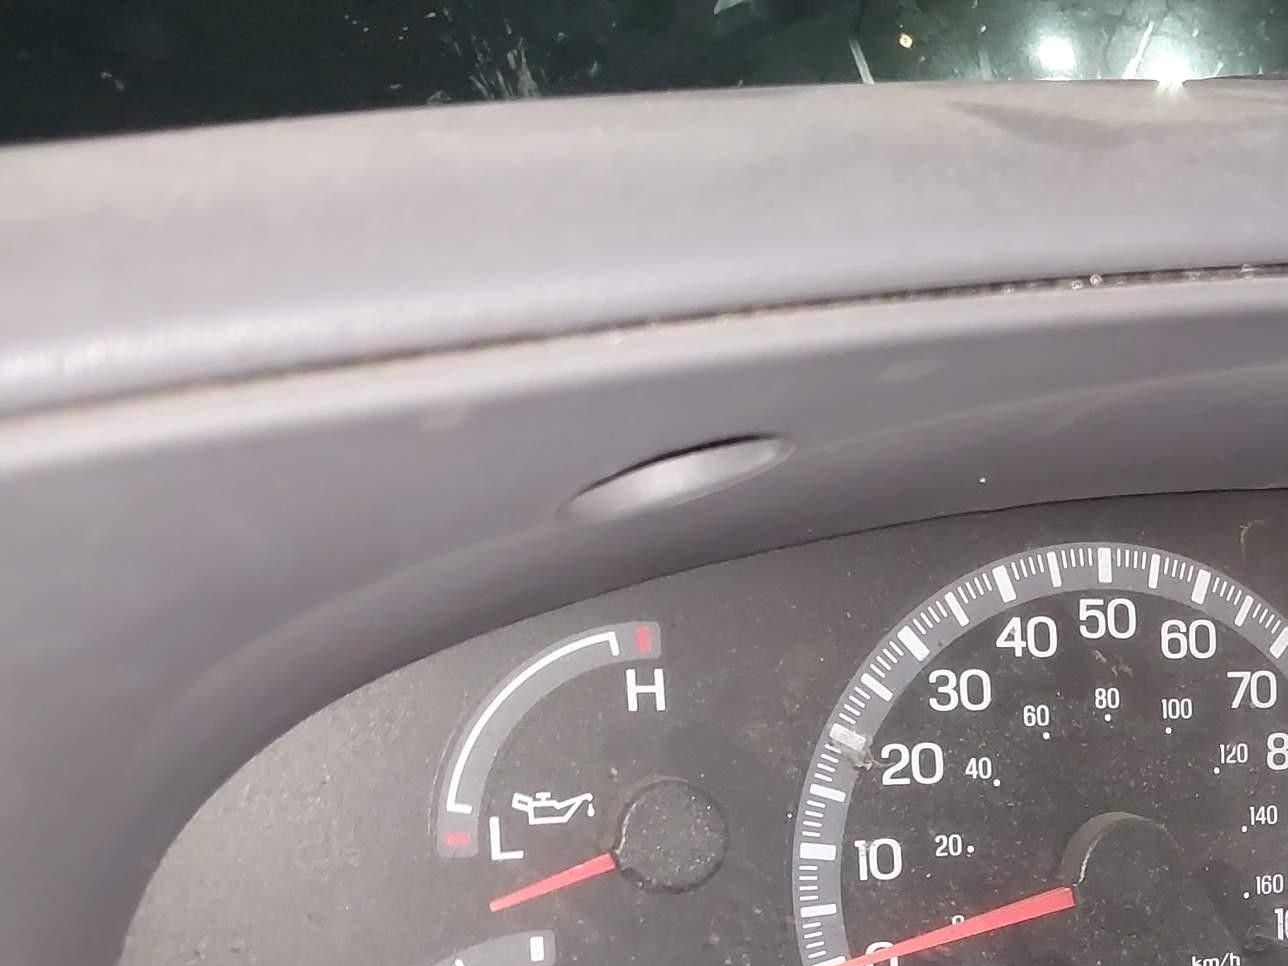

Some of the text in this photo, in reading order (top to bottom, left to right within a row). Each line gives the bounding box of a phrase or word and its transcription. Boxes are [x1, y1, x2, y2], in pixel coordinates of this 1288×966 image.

[995, 614, 1058, 658] 40
[1078, 598, 1137, 640] 50
[1159, 618, 1218, 661] 60
[624, 667, 668, 713] H
[927, 667, 993, 712] 30
[1094, 686, 1120, 711] 80
[1160, 697, 1193, 721] 100
[1225, 668, 1279, 710] 70
[1022, 704, 1050, 728] 60
[880, 741, 945, 786] 20
[964, 756, 993, 781] 40
[1218, 742, 1249, 766] 120
[1248, 804, 1279, 828] 140
[489, 815, 524, 861] L
[934, 832, 964, 857] 20
[855, 837, 903, 882] 10
[1254, 873, 1285, 896] 160
